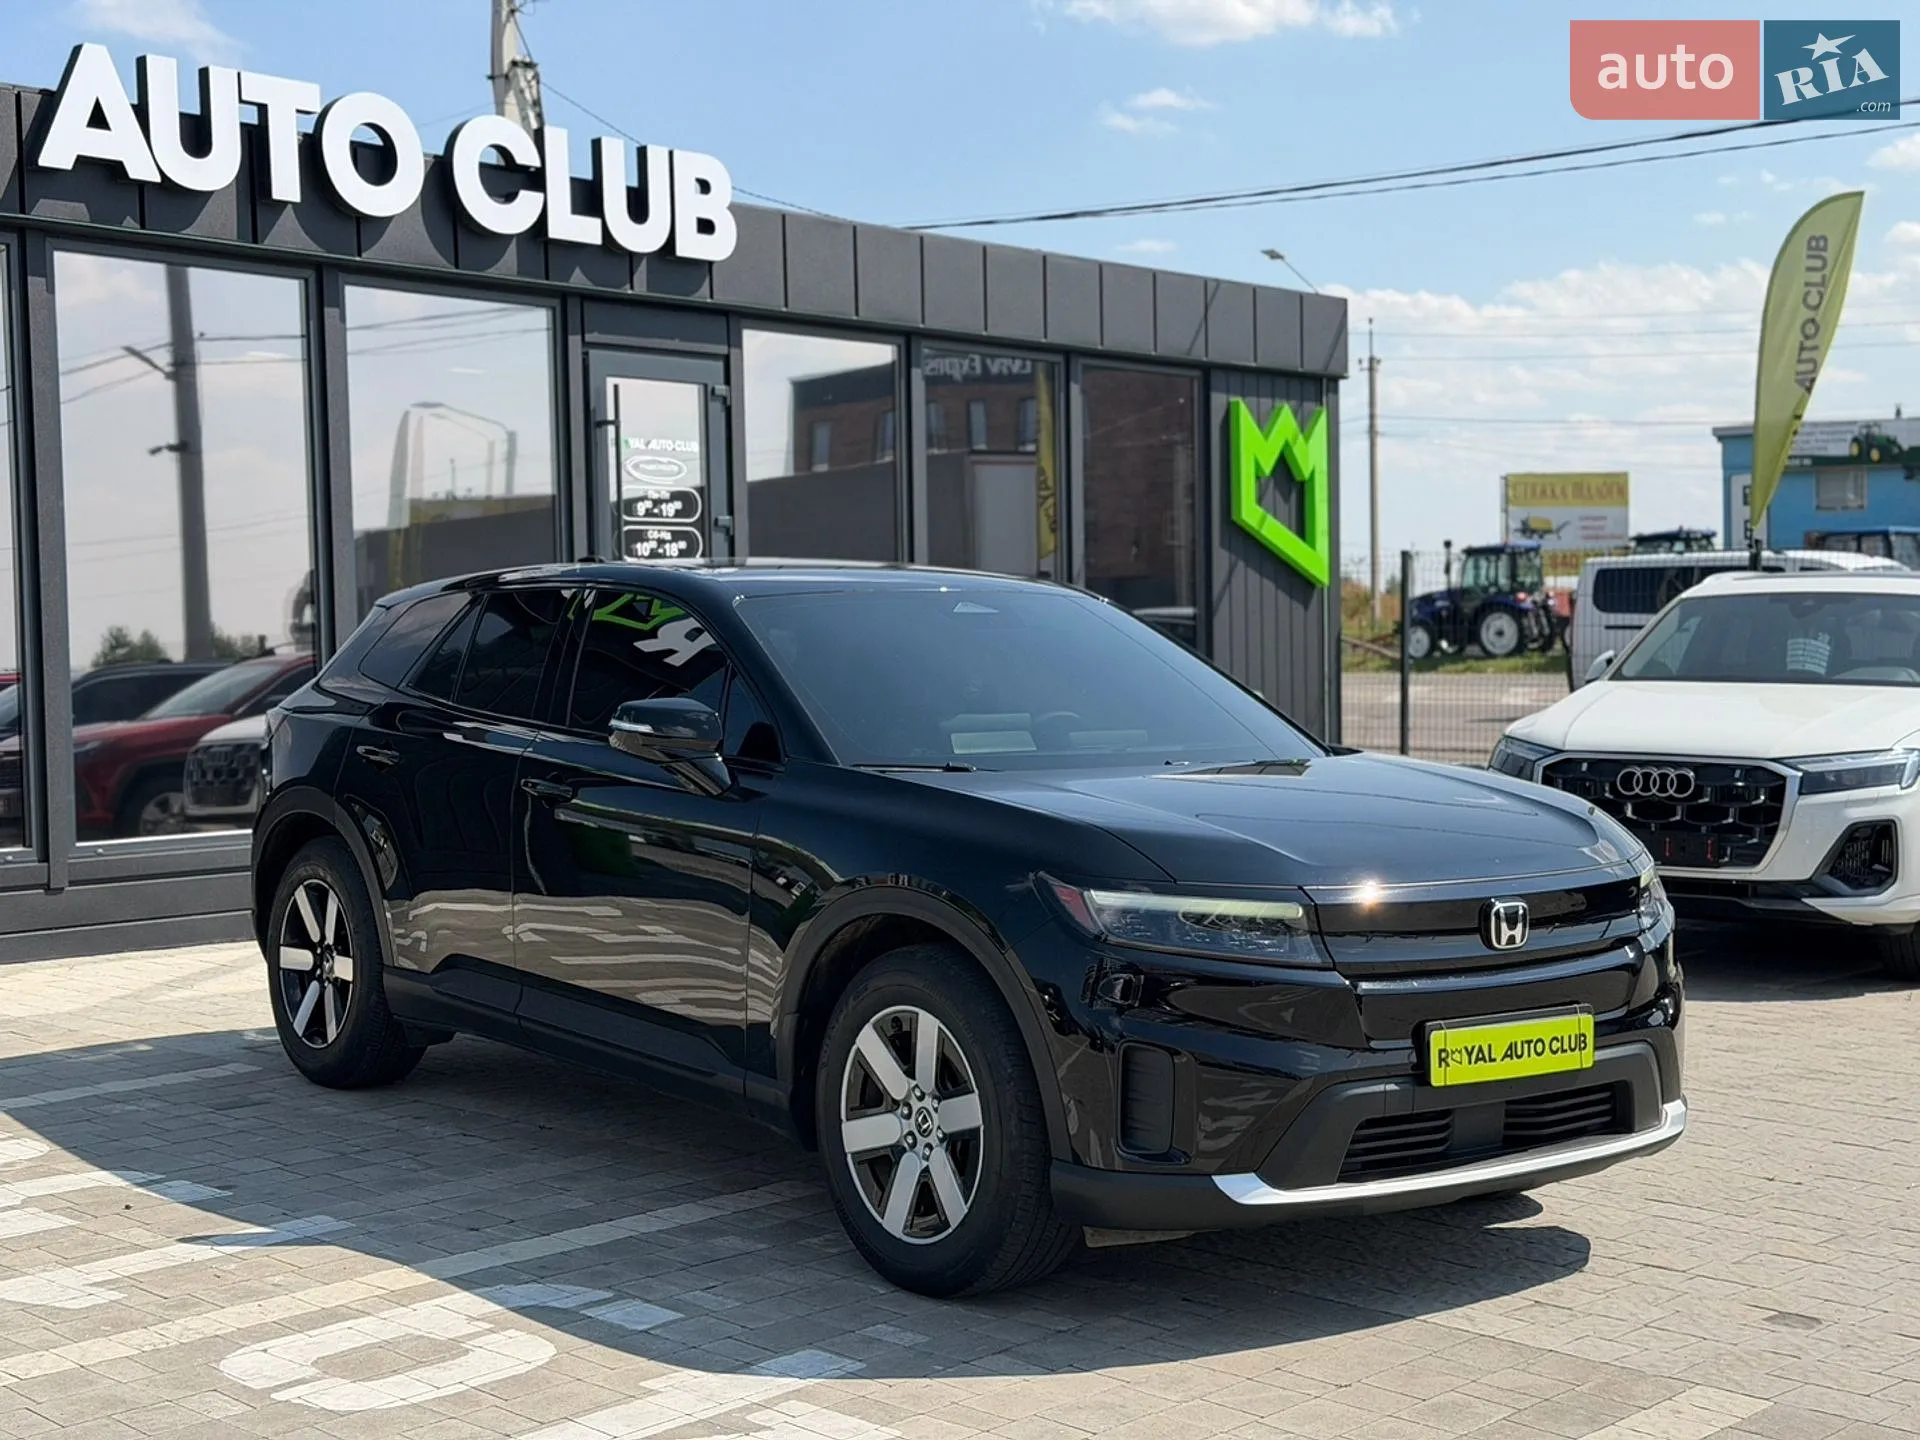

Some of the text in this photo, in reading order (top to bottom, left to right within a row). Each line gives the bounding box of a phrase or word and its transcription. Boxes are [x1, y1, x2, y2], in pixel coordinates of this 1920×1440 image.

[38, 43, 738, 262] AUTO CLUB
[1802, 234, 1828, 312] CLUB
[1795, 317, 1822, 397] AUTO
[1501, 1037, 1546, 1062] AUTO
[1549, 1032, 1588, 1056] CLUB
